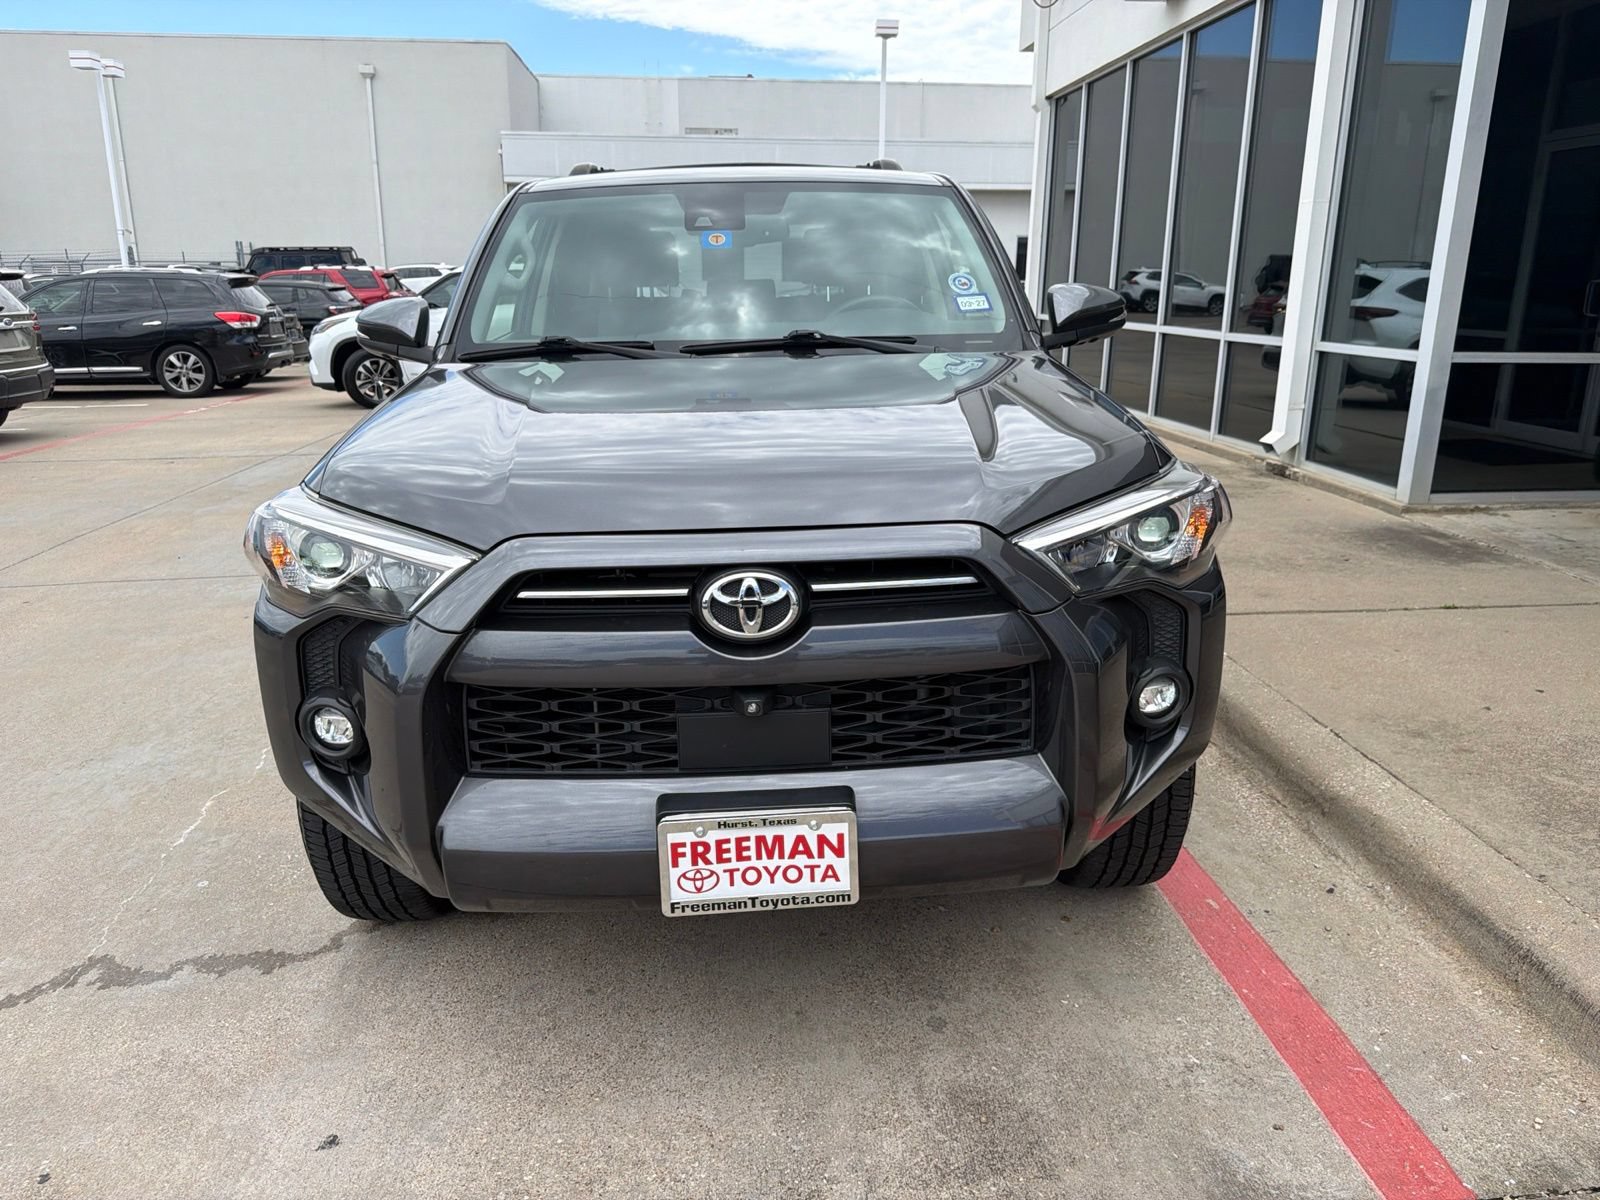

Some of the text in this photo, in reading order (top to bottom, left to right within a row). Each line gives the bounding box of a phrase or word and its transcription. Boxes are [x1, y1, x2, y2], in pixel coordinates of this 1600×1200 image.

[762, 818, 797, 827] Texas
[670, 833, 845, 868] FREEMAN
[723, 864, 841, 887] TOYOTA
[670, 893, 852, 914] FreemanToyota.com
